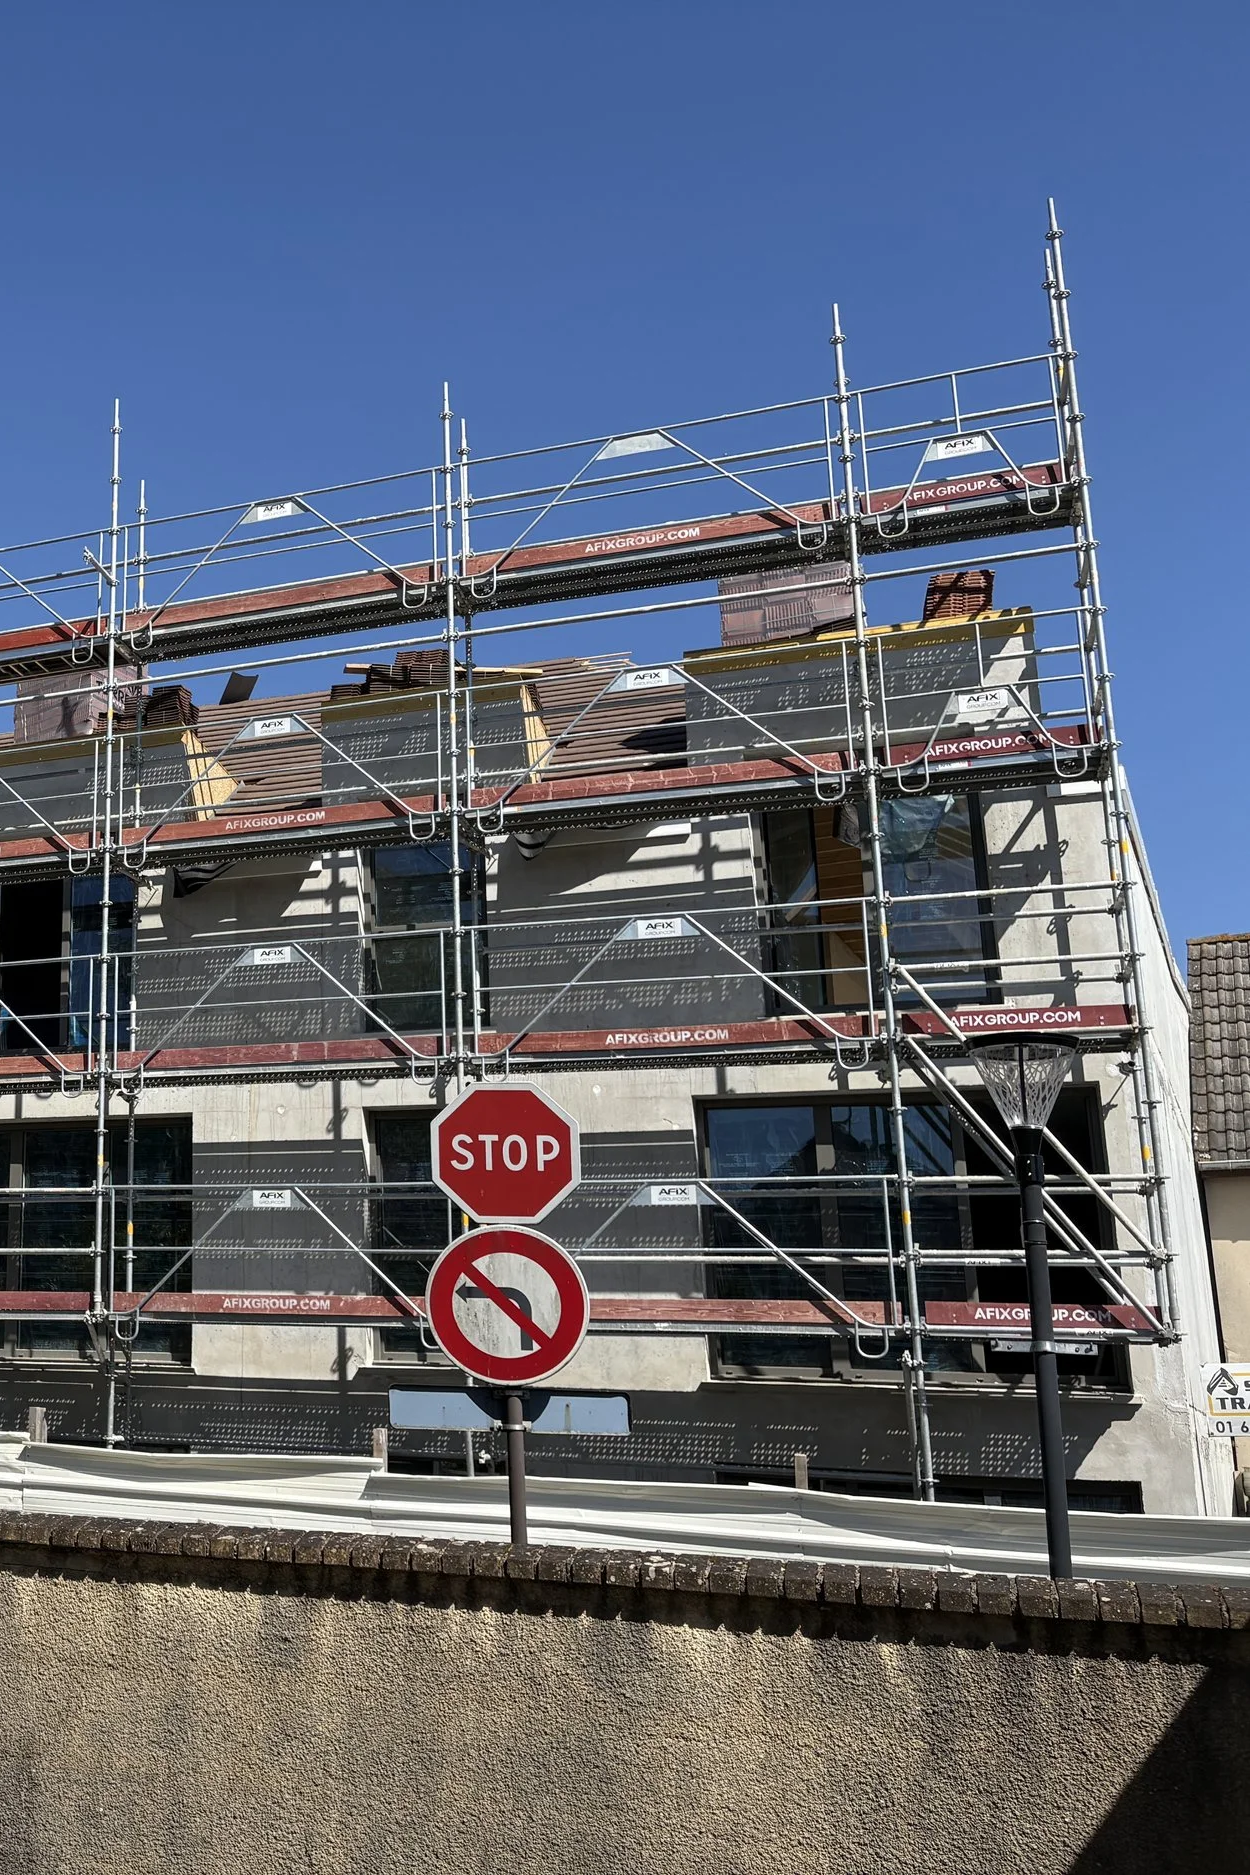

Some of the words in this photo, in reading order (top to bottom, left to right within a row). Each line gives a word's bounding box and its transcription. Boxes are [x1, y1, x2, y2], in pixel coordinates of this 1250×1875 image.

[944, 438, 975, 450] AFIX
[585, 527, 700, 553] AFIXGROUP.COM
[633, 671, 661, 681] AFIX
[967, 692, 999, 703] AFIX
[260, 720, 284, 729] AFIX
[225, 811, 326, 830] AFIXGROUP.COM
[645, 921, 674, 930] AFIX
[260, 949, 284, 957] AFIX
[950, 1011, 1081, 1028] AFIXGROUP.COM
[605, 1029, 729, 1046] AFIXGROUP.COM
[450, 1133, 560, 1172] STOP
[658, 1187, 688, 1196] AFIX
[223, 1298, 331, 1310] AFIXGROUP.COM
[1216, 1421, 1233, 1433] 01
